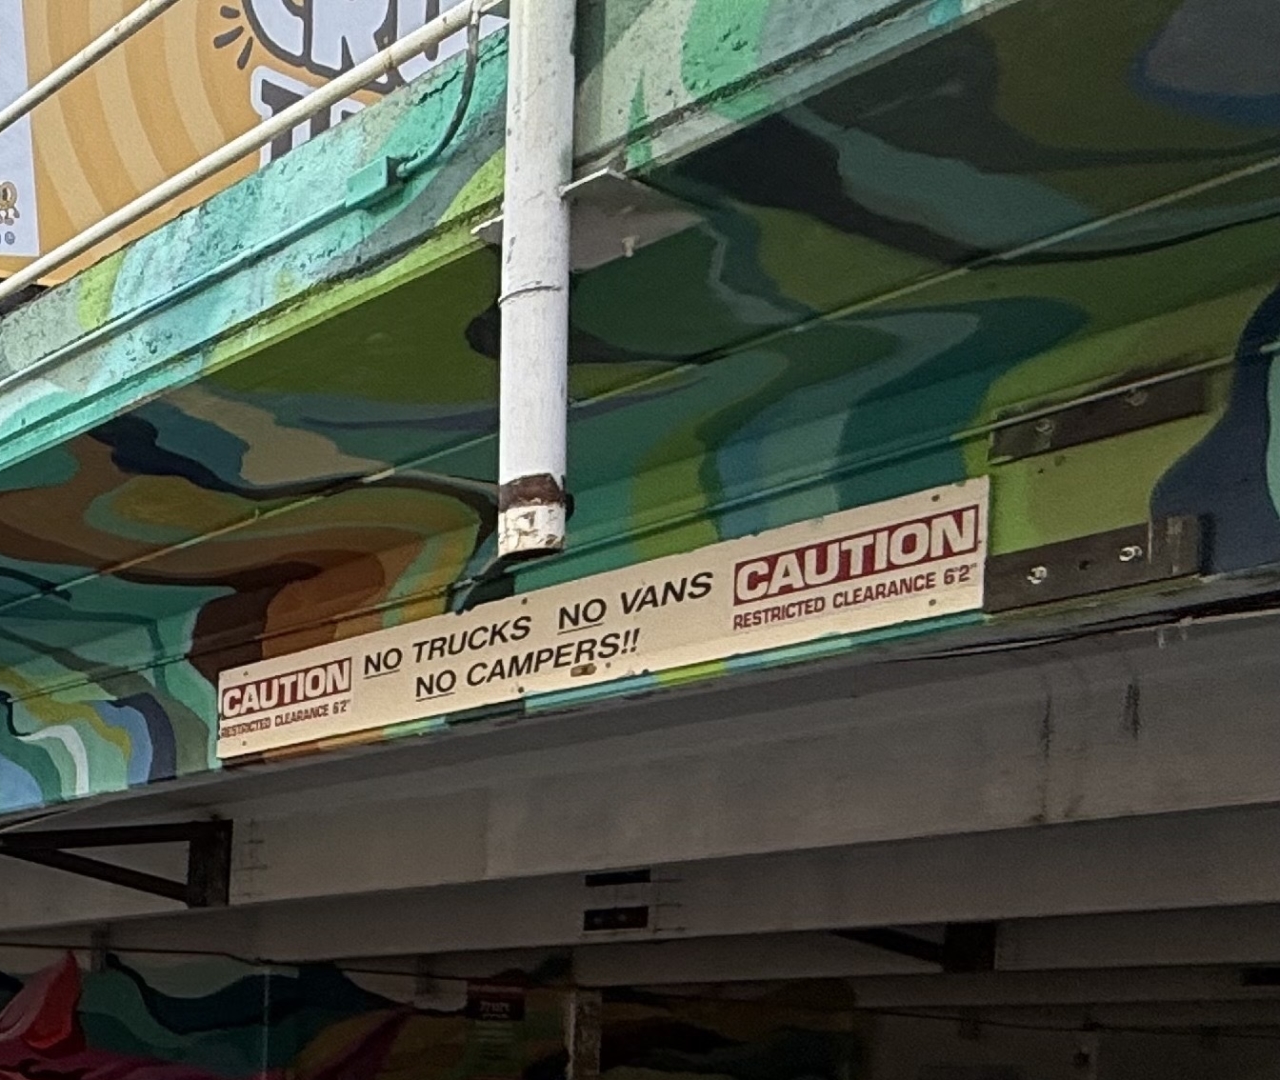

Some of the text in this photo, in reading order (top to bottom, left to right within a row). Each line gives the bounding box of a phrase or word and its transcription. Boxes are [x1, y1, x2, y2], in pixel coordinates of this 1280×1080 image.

[735, 507, 977, 601] CAUTION
[363, 571, 714, 676] NO TRUCKS NO VANS
[733, 597, 826, 631] RESTRICTED
[833, 572, 937, 609] CLEARANCE
[222, 658, 351, 718] CAUTION
[415, 628, 640, 698] NO CAMPERS!!
[220, 716, 271, 738] RESTRICTED
[274, 703, 330, 728] CLEARANCE
